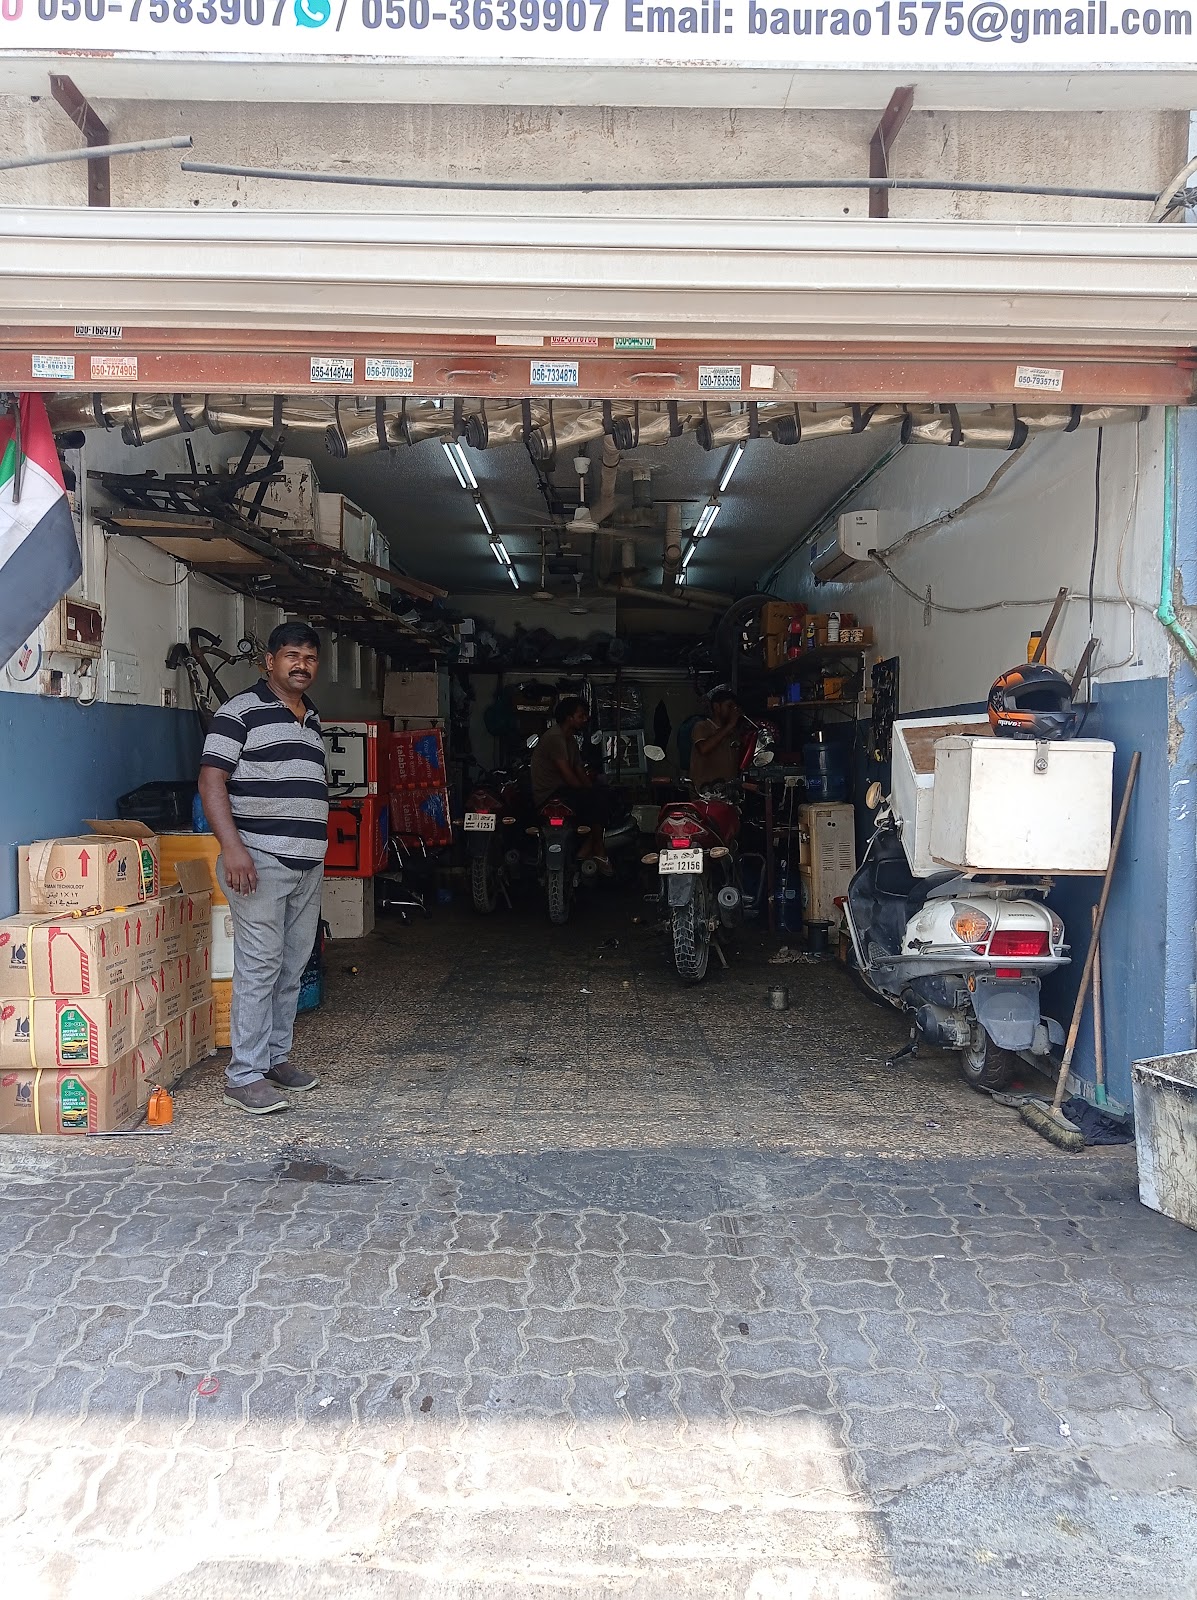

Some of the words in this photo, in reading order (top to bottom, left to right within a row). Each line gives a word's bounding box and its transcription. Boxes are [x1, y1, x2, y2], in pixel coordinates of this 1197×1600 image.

[38, 0, 287, 27] 050-7583907
[361, 0, 609, 32] 050-3639907
[624, 0, 734, 34] Email:
[748, 1, 1193, 43] baurao1575@gmail.com
[91, 365, 137, 377] 050-7274905
[366, 366, 412, 378] 056-9708932
[532, 368, 577, 382] 056-7334878
[1018, 375, 1060, 387] 050-7935713
[396, 744, 408, 779] talabat
[402, 804, 412, 833] talaba
[677, 861, 700, 870] 12156
